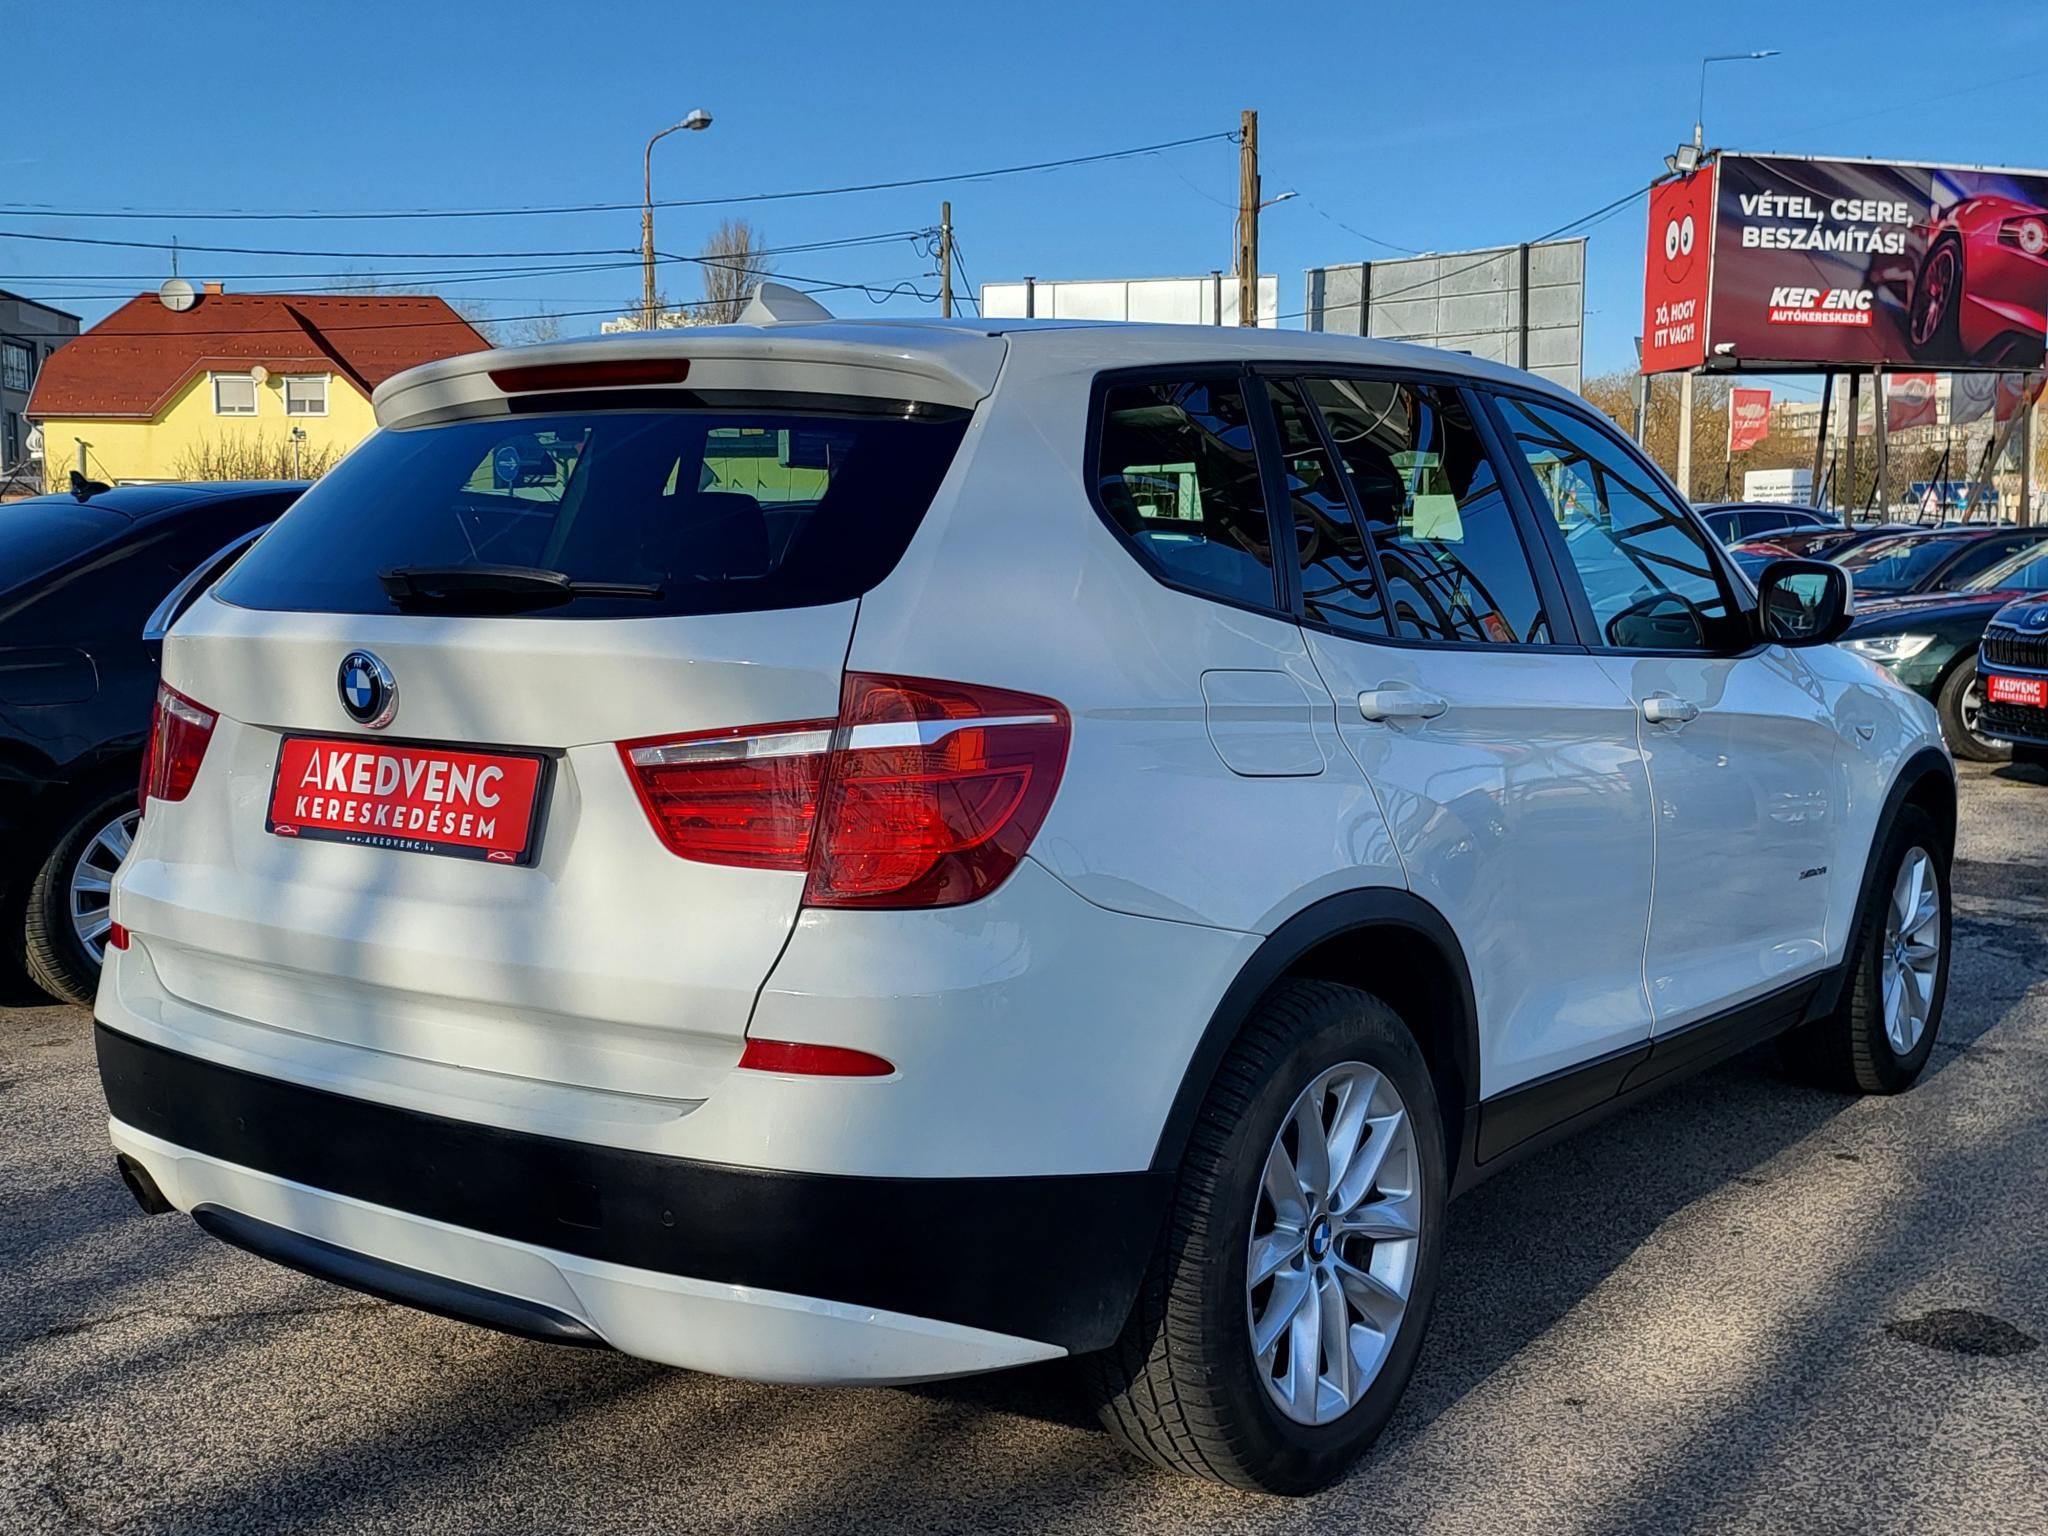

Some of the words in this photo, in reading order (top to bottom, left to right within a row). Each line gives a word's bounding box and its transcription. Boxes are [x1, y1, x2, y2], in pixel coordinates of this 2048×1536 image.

[1739, 190, 1824, 223] VÉTEL,
[1830, 198, 1914, 228] CSERE,
[1742, 223, 1906, 255] BESZÁMÍTÁS!
[1655, 301, 1669, 326] JÓ,
[1671, 299, 1696, 322] HOGY
[1655, 328, 1668, 348] ITT
[1669, 323, 1695, 345] VAGY!
[300, 747, 504, 808] AKEDVENC
[295, 796, 496, 840] KERESKEDÉSEM
